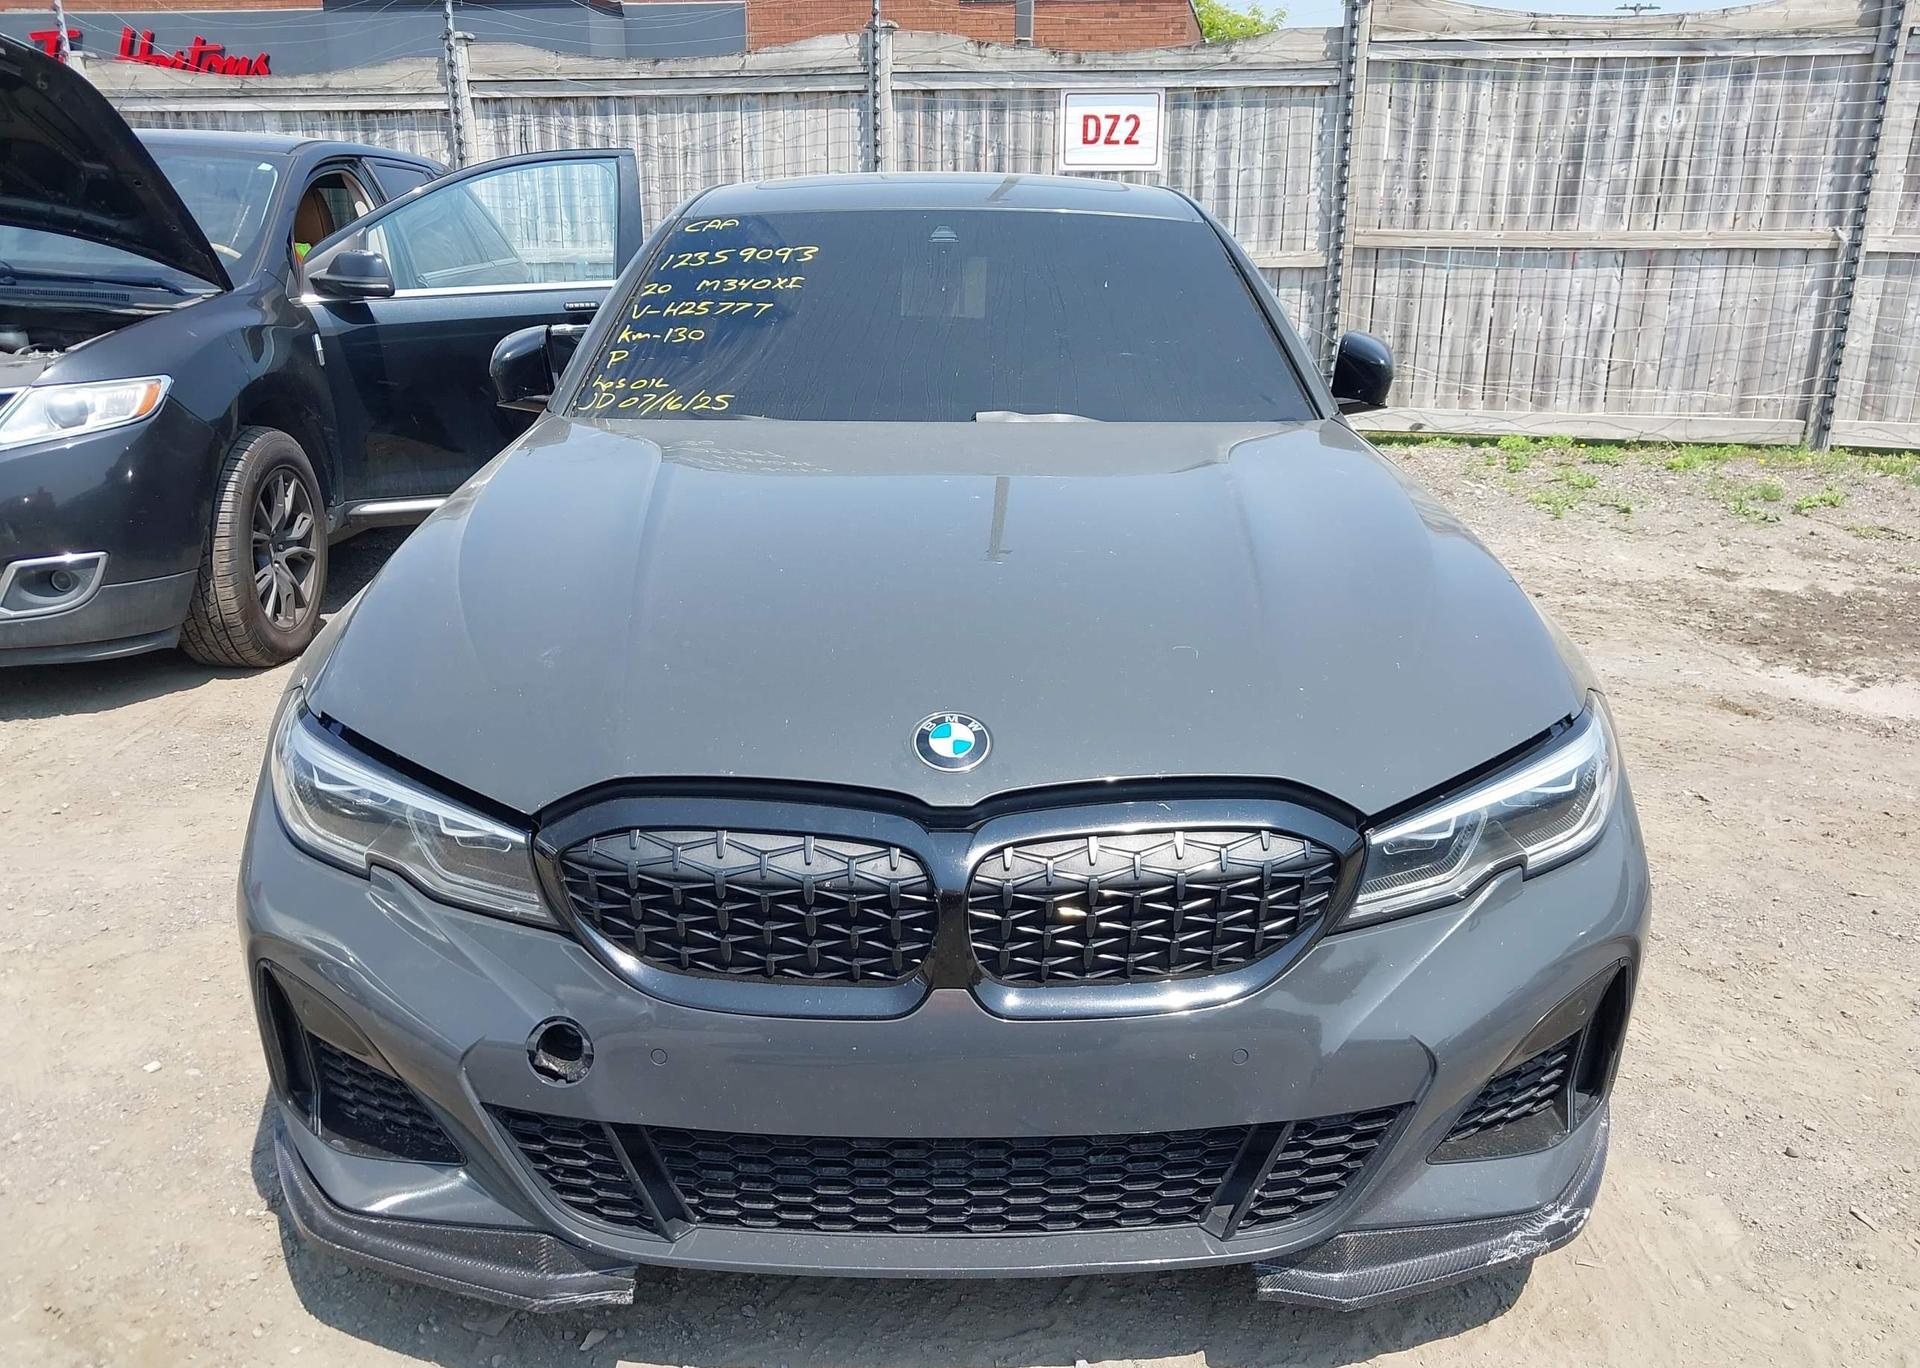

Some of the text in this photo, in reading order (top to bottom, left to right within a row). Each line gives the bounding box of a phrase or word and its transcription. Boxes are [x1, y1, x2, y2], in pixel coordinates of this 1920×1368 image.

[1082, 114, 1141, 145] DZ2
[660, 246, 819, 270] 12359093
[641, 283, 672, 296] 20
[606, 350, 629, 369] P
[618, 389, 736, 416] 07/16/25
[922, 714, 983, 732] BMW
